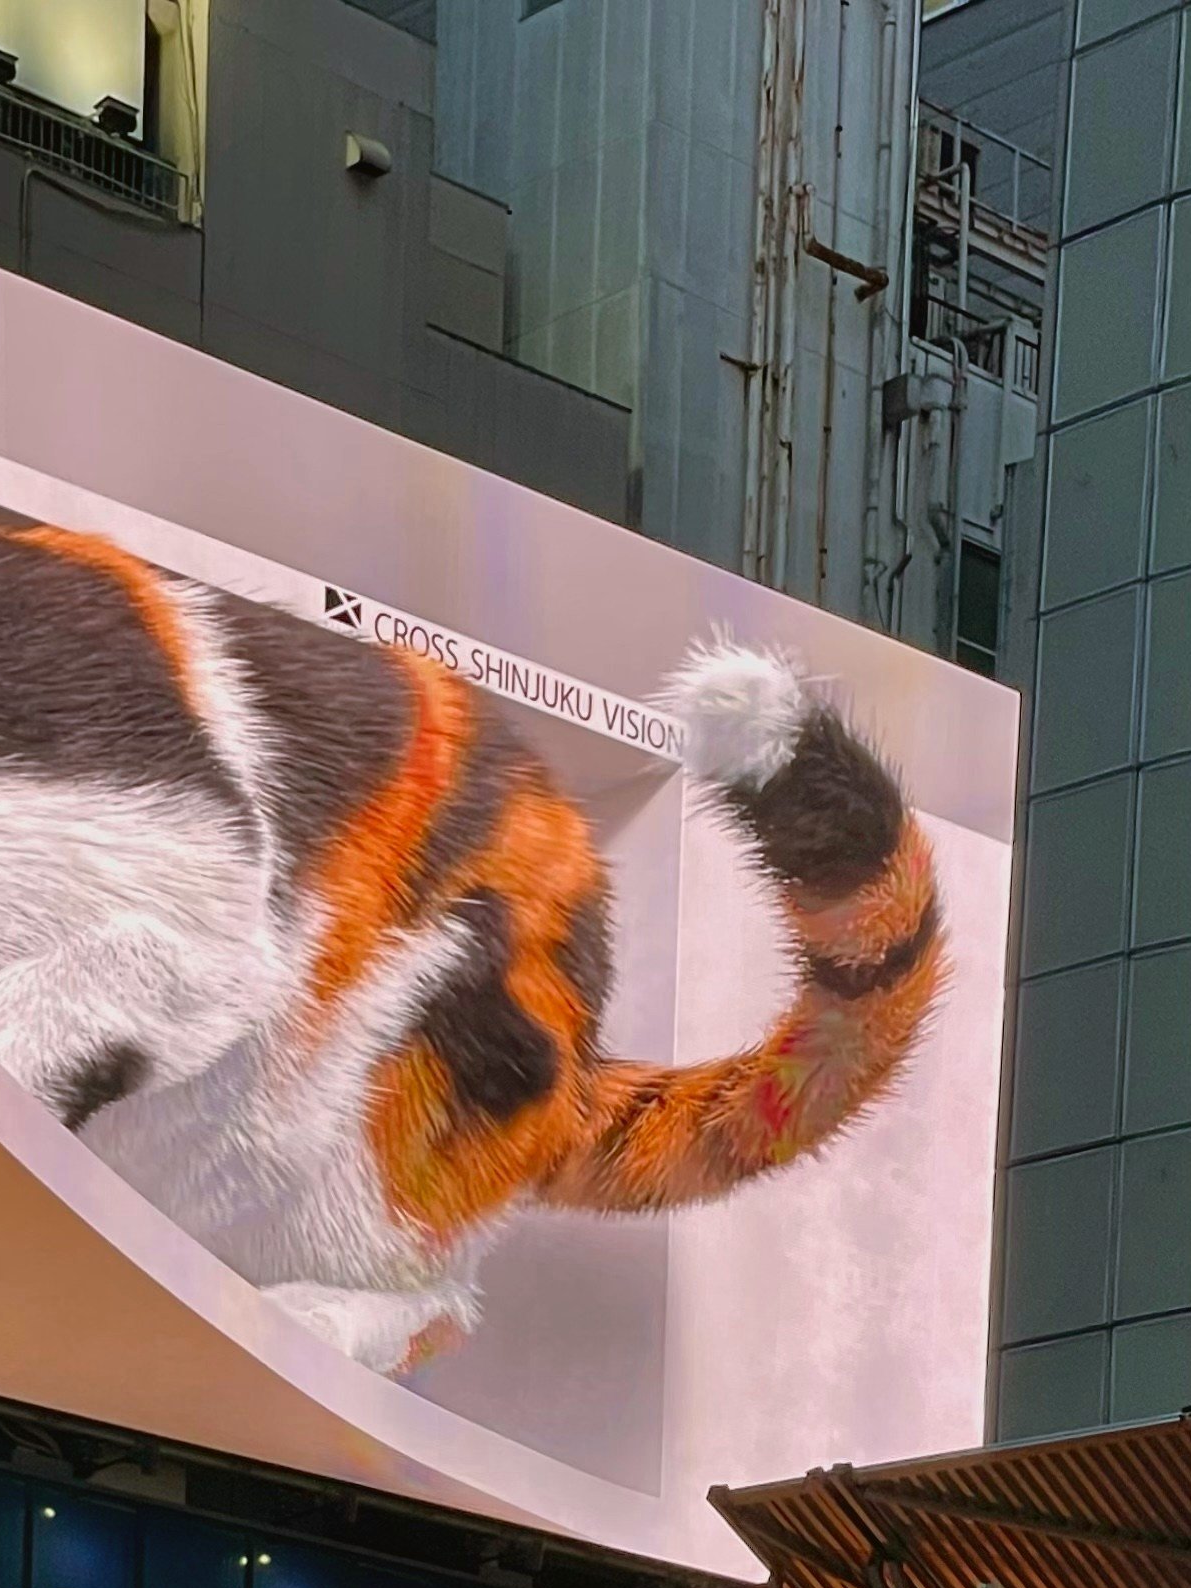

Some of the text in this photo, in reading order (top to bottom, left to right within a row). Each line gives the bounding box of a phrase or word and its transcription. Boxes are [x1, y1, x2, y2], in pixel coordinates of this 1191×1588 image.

[374, 611, 684, 757] CROSS SHINJUKU VISION
